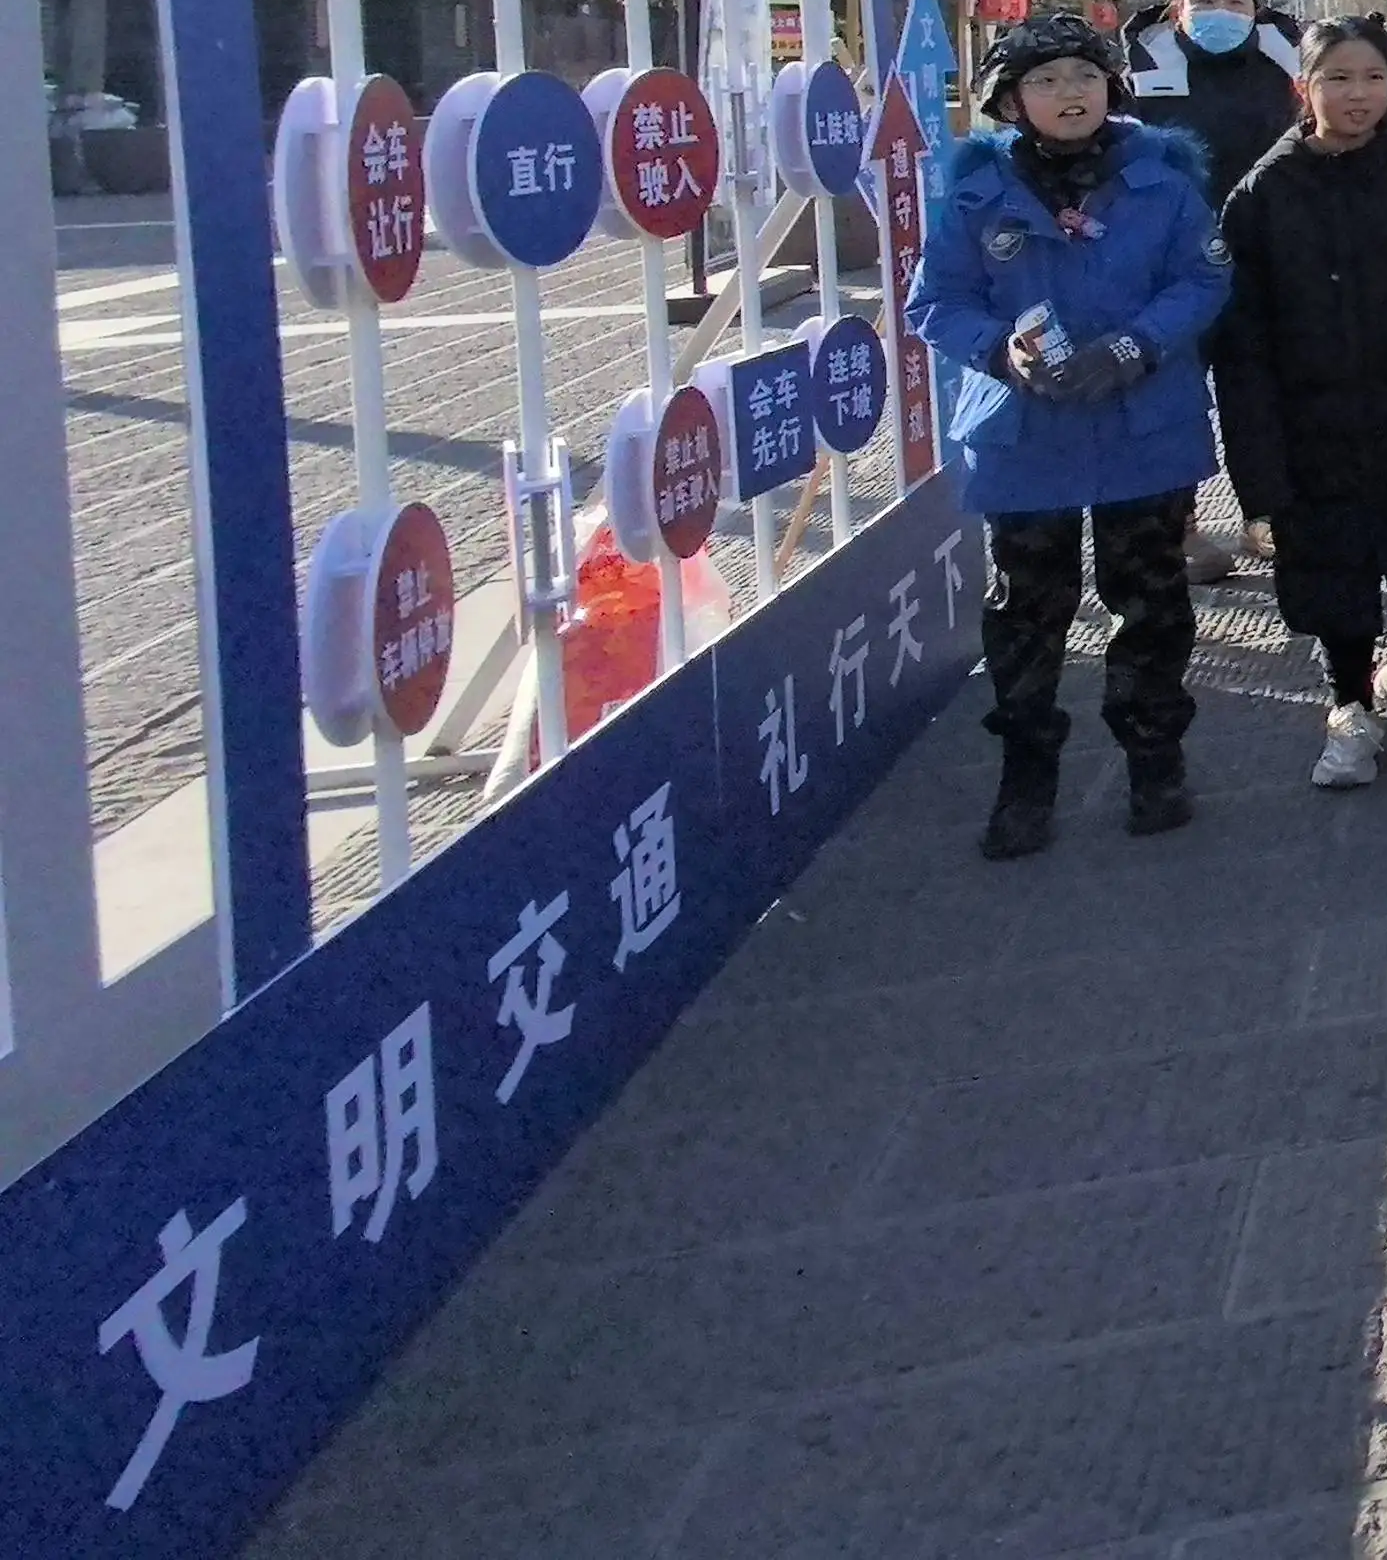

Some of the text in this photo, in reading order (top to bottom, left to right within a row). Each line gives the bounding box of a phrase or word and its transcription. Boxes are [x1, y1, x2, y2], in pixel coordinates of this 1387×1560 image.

[362, 120, 409, 185] 会车
[632, 100, 700, 152] 禁止
[507, 143, 577, 197] 直行
[635, 154, 702, 208] 驶入
[367, 194, 414, 261] 让行
[891, 137, 927, 443] 遵守交法规
[827, 342, 872, 386] 连续
[750, 369, 799, 421] 会车
[829, 384, 873, 427] 下坡
[752, 417, 802, 472] 先行
[98, 526, 966, 1512] 文明交通 礼行天下
